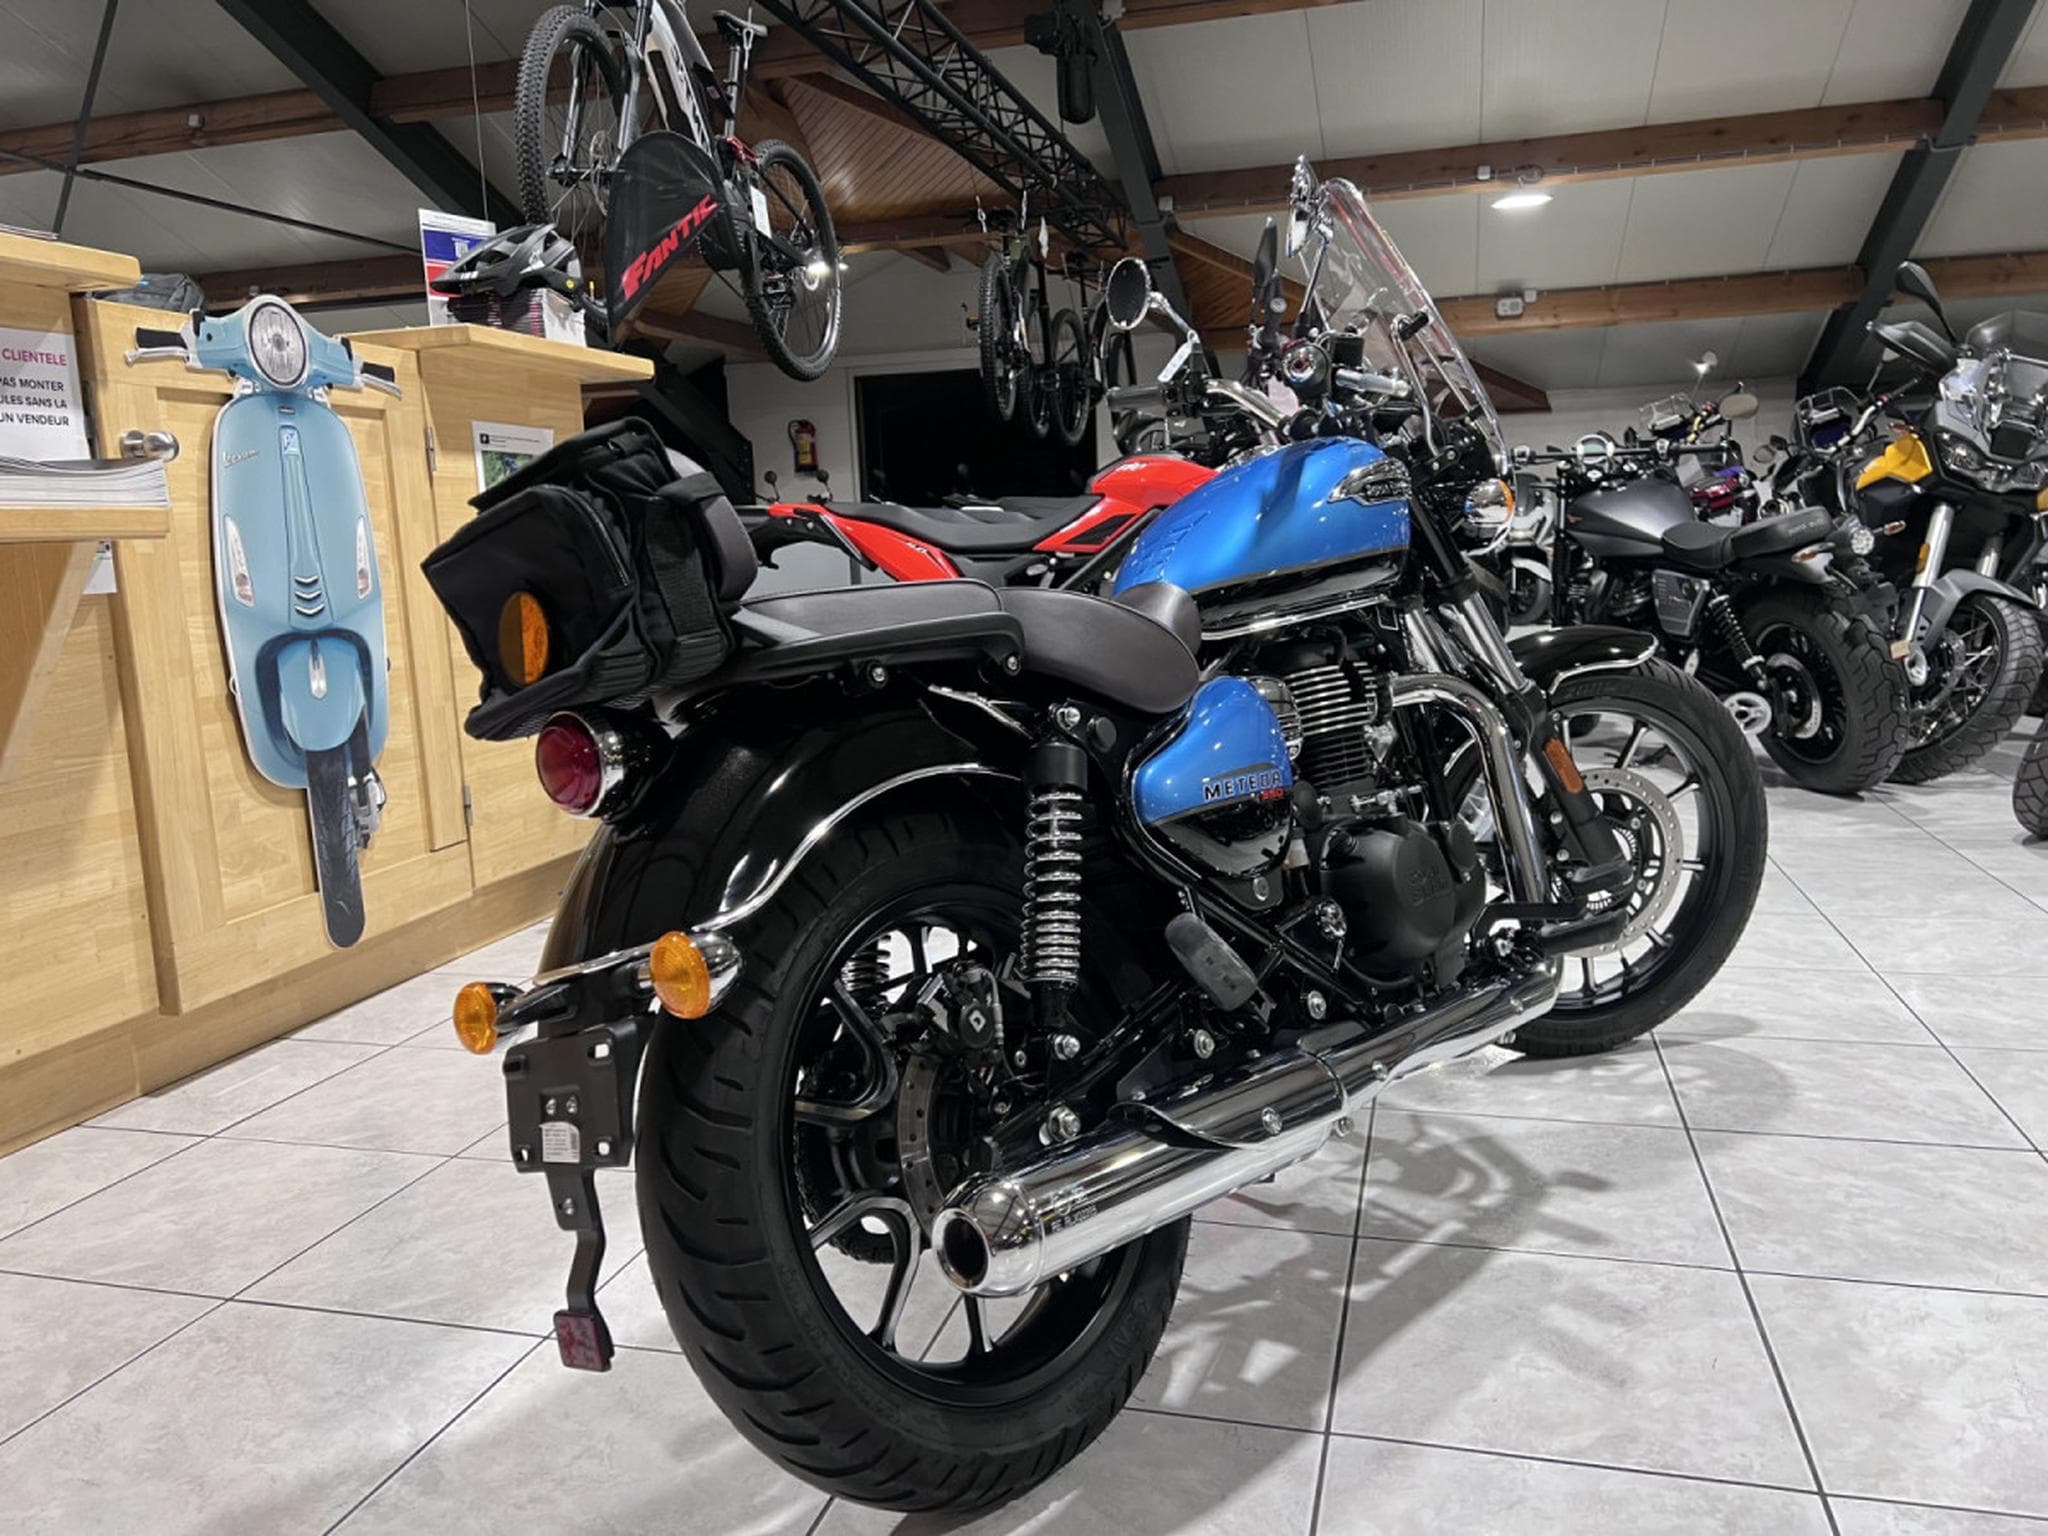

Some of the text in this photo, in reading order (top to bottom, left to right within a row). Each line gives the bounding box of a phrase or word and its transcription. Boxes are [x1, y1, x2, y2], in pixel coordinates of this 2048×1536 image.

[622, 194, 718, 299] FANTIC
[19, 379, 64, 391] MONTER
[25, 396, 52, 408] SANS
[54, 399, 67, 408] LA
[16, 413, 69, 426] VENDEUR
